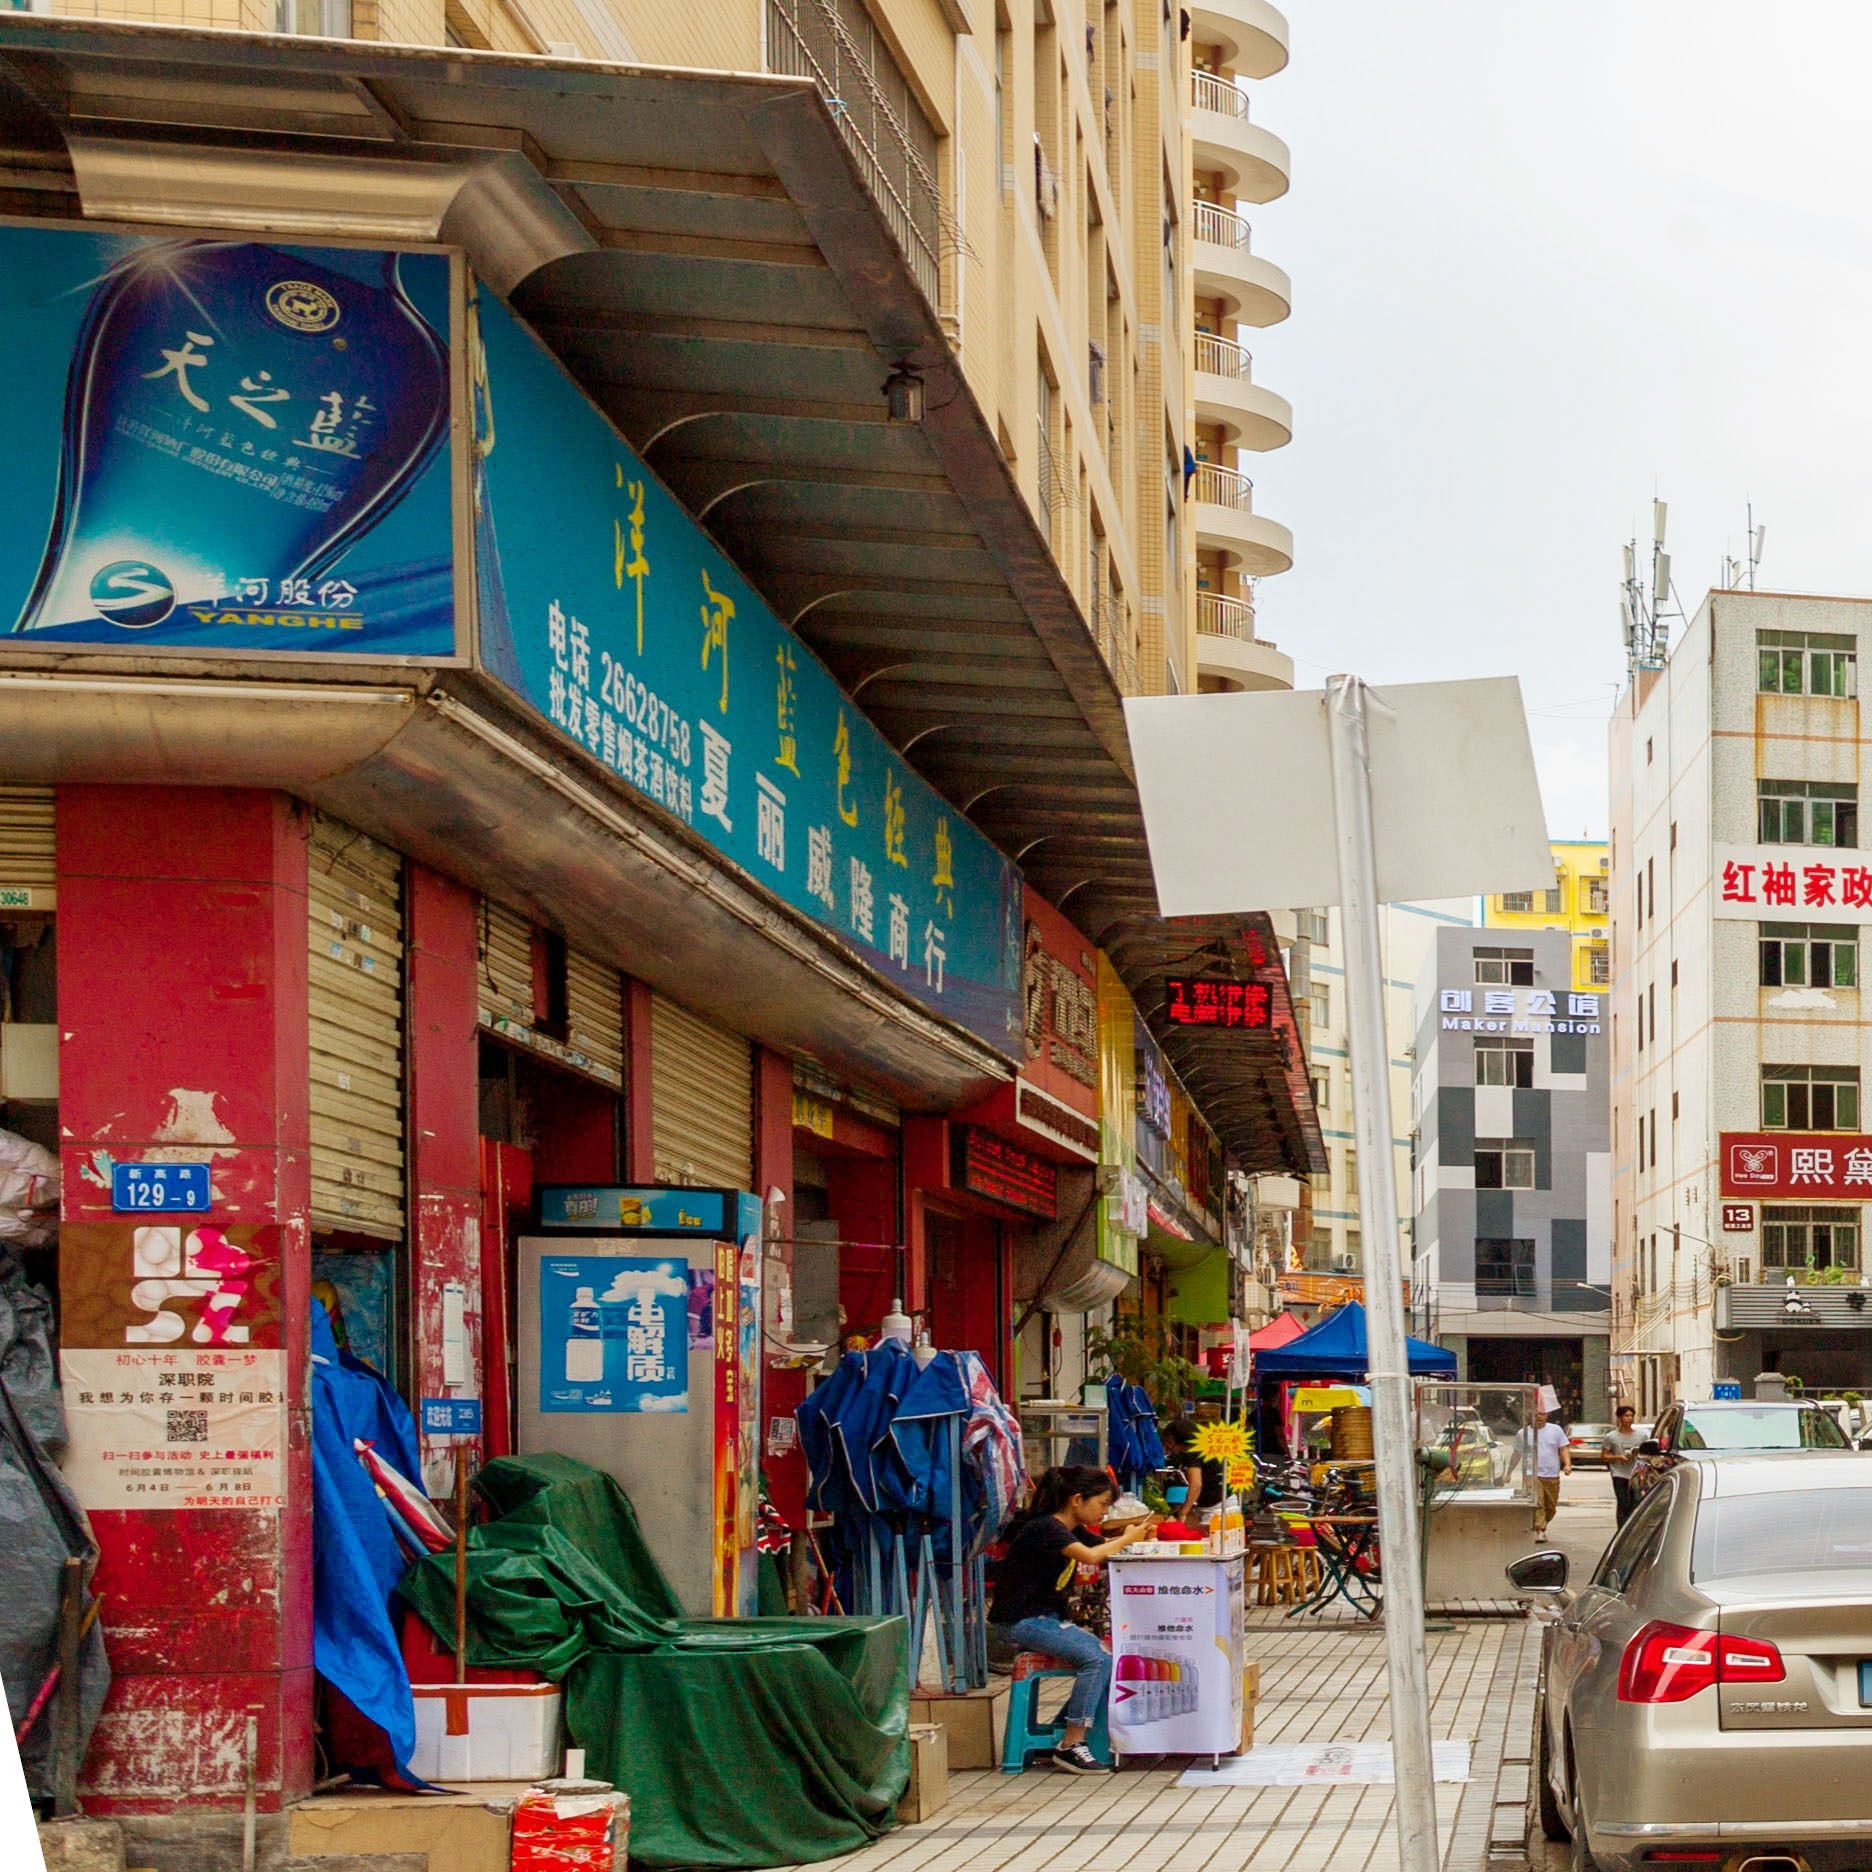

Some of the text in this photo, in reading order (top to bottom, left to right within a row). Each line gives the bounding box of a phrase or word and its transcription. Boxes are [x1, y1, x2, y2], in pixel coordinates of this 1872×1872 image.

[190, 612, 364, 629] YANGHE
[548, 599, 692, 768] 电话 26628758
[549, 671, 693, 825] 批发零售烟茶酒饮料
[700, 719, 946, 994] 夏丽威隆商行
[1440, 990, 1600, 1016] 创客公馆
[1442, 1017, 1601, 1034] Maker Mansion
[127, 1182, 196, 1206] 129-9
[1726, 1209, 1750, 1222] 13
[116, 1353, 258, 1367] 初心十年 胶囊一梦
[158, 1372, 215, 1387] 深职院
[102, 1449, 275, 1462] 扫一扫参与活动 史上最强福利
[126, 1482, 171, 1493] 6月4日
[1158, 1585, 1204, 1595] 维他命水
